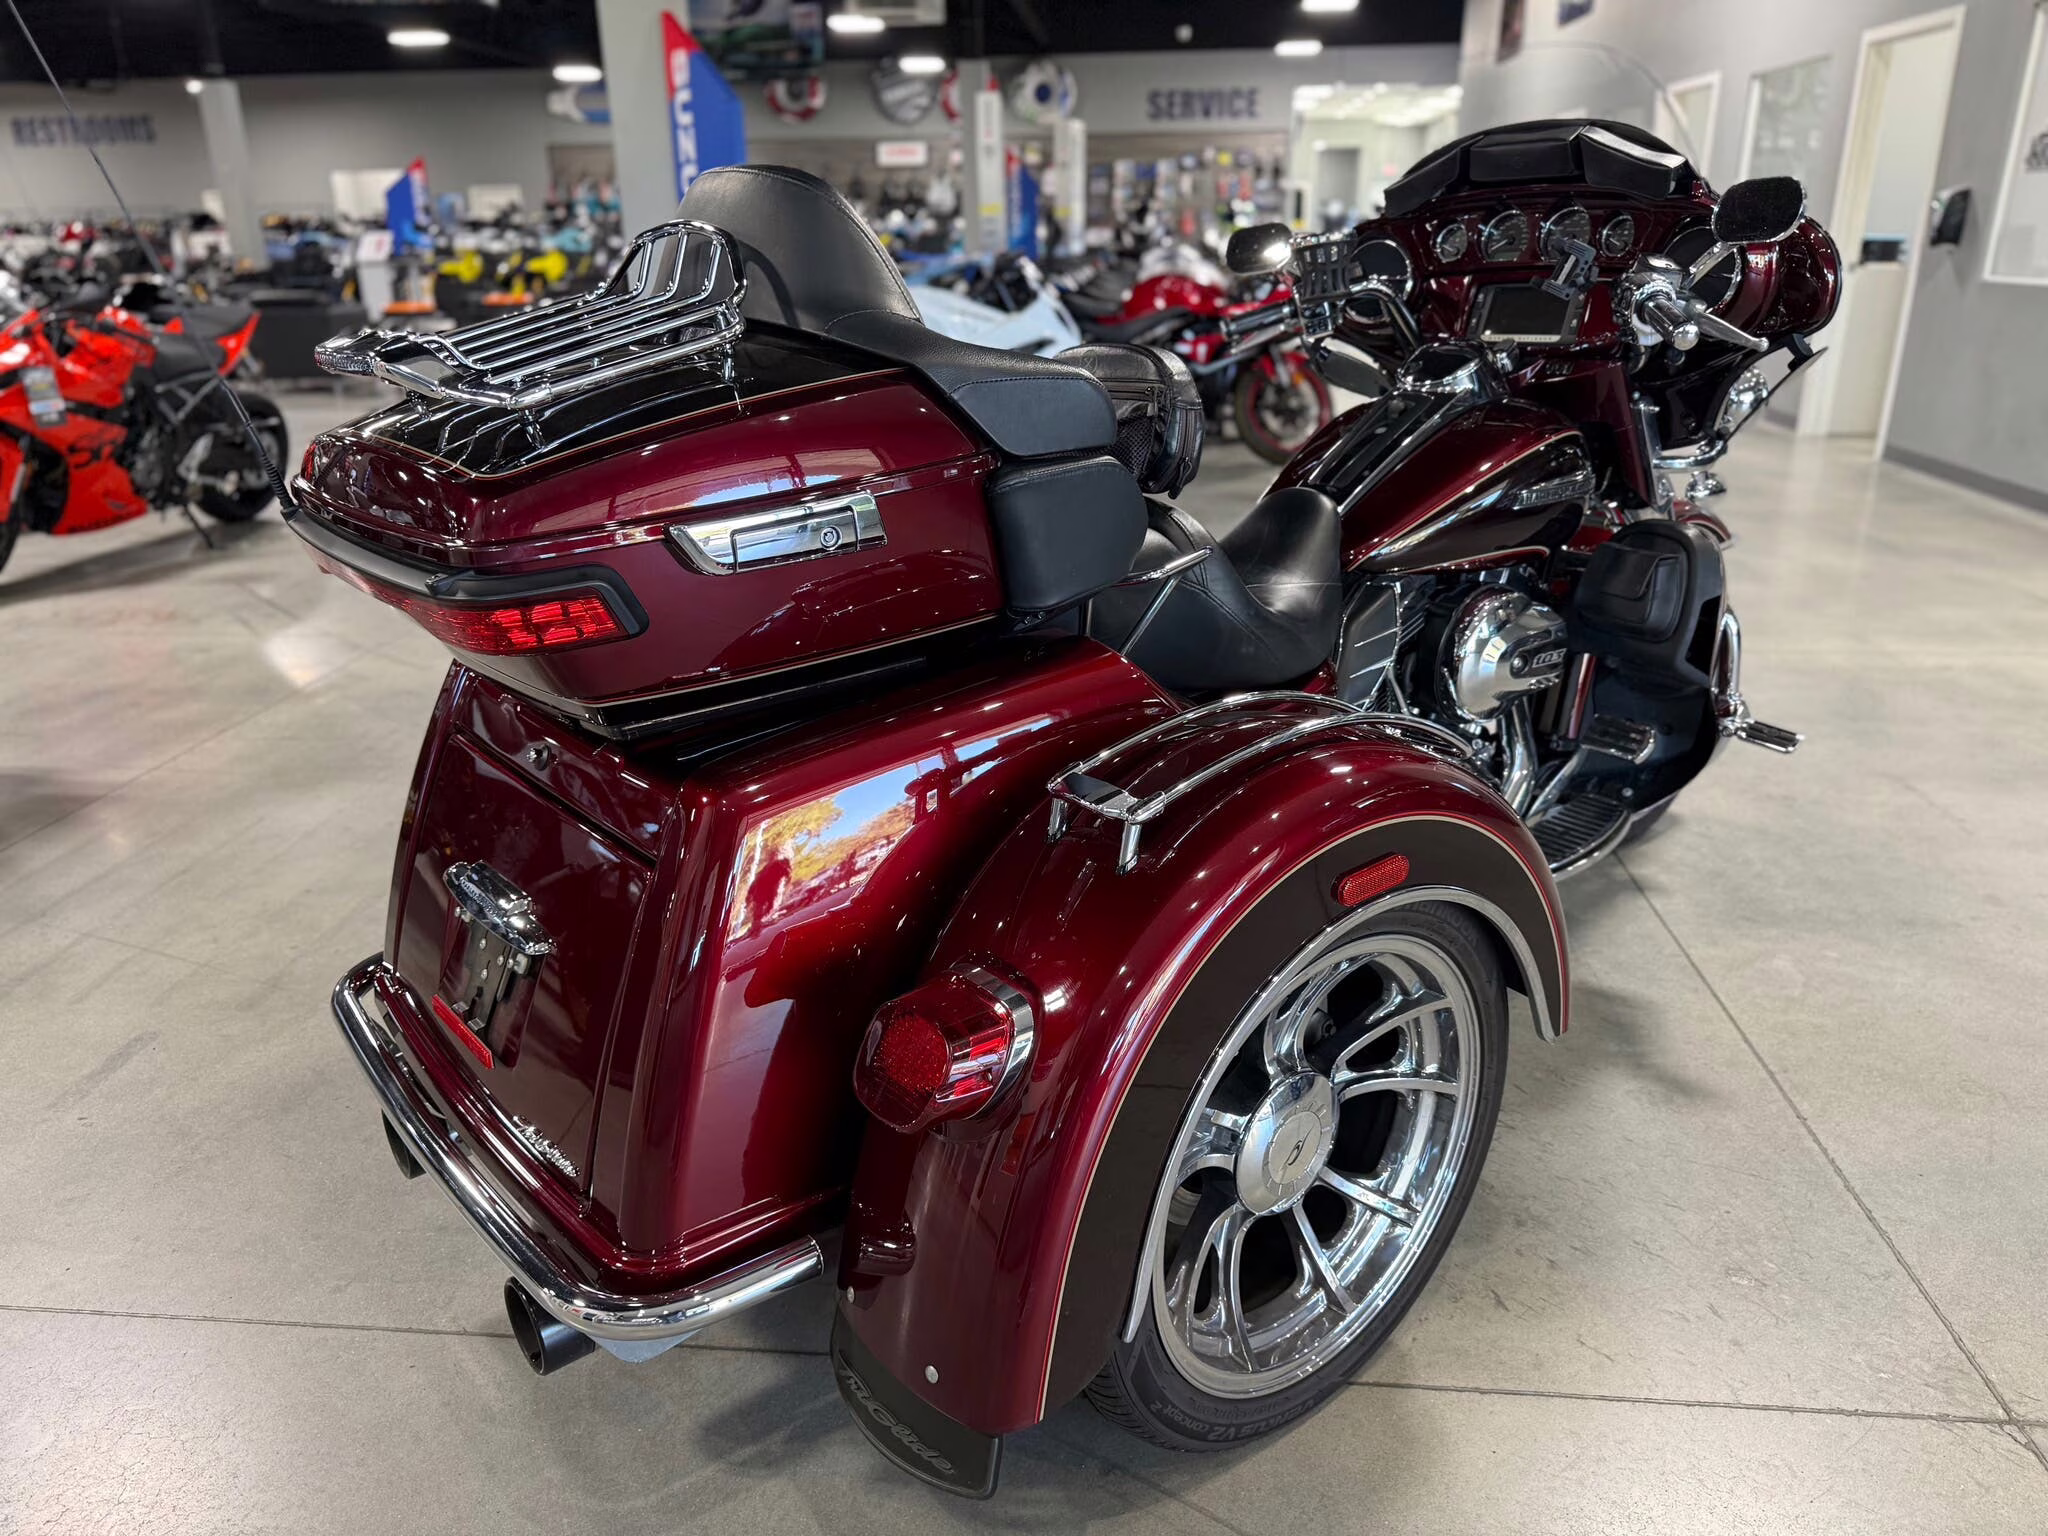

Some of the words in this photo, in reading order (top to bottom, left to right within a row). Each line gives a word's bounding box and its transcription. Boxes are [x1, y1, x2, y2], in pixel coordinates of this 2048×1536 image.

[1147, 87, 1259, 120] SERVICE
[11, 115, 156, 147] RESTROOMS
[1163, 1404, 1210, 1433] concept
[1206, 1426, 1236, 1441] V2
